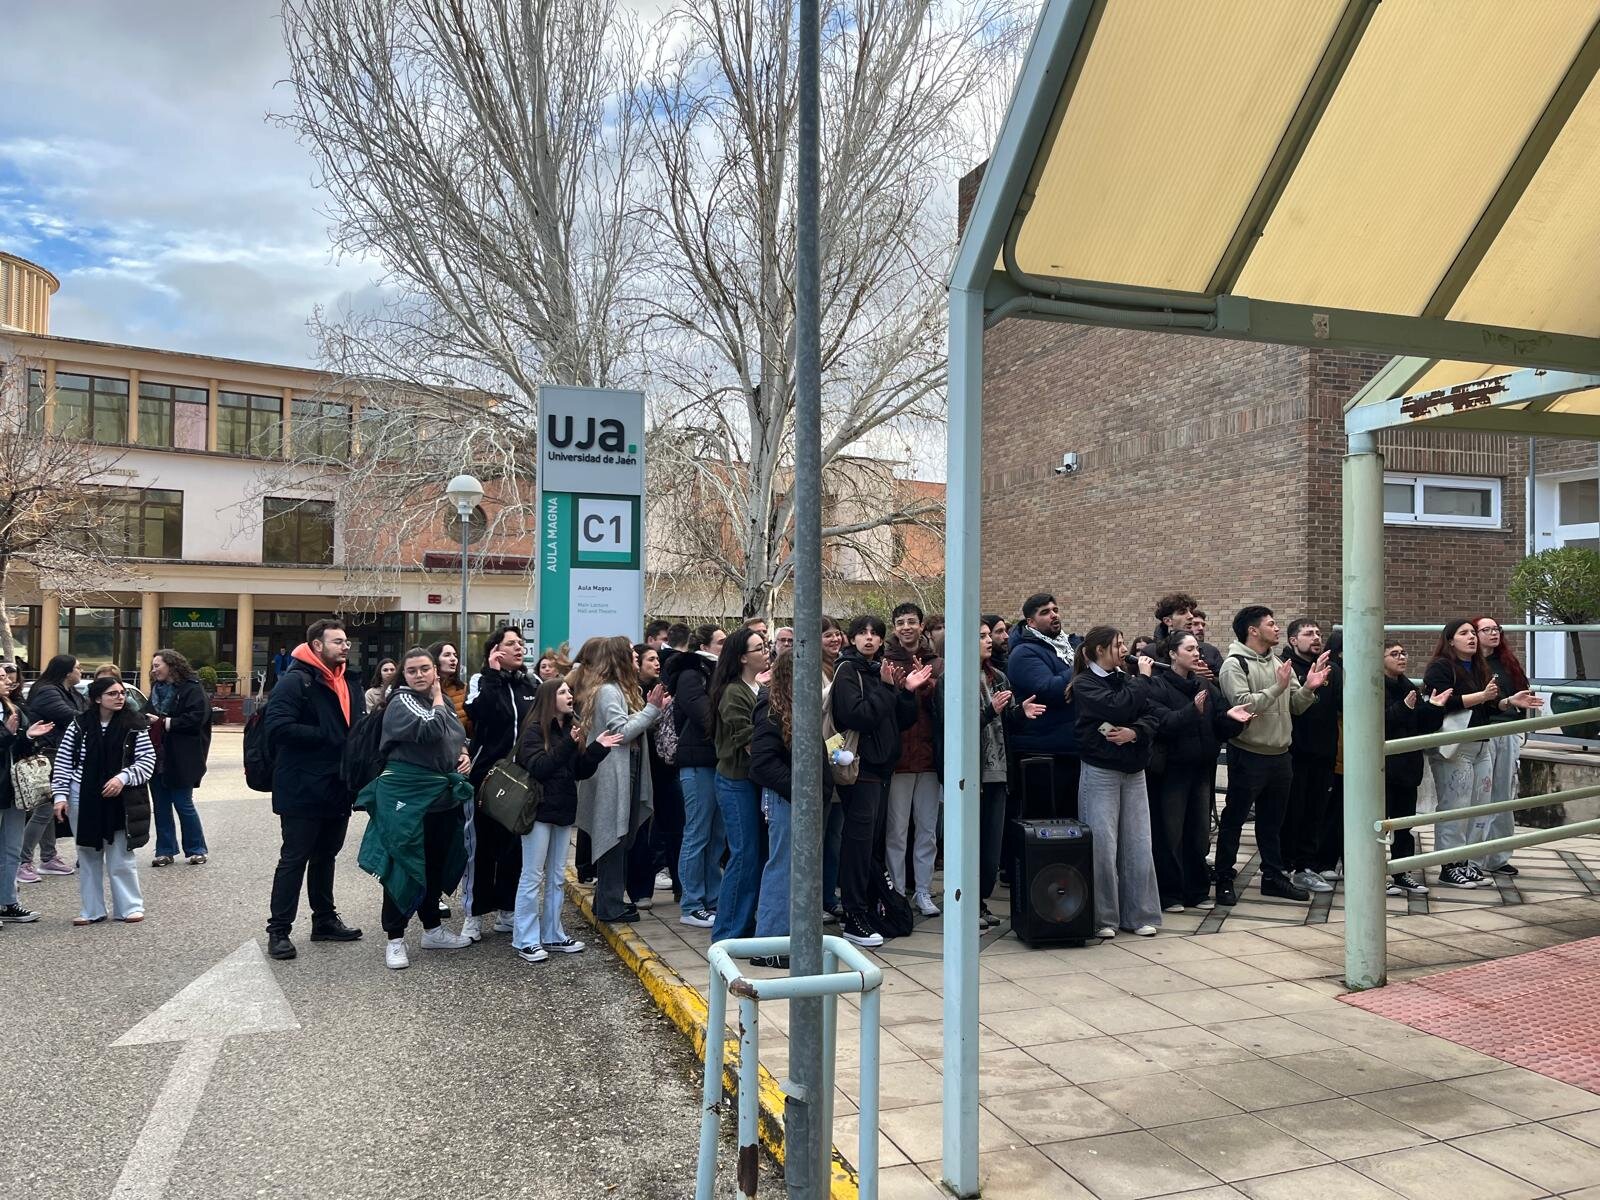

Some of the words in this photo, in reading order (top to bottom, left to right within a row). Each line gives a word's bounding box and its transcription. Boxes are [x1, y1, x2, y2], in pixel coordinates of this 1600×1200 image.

[548, 451, 601, 463] Universidad
[603, 454, 614, 464] de
[615, 454, 637, 465] Jaén
[547, 497, 558, 539] MAGNA
[583, 514, 621, 544] C1
[547, 542, 557, 573] AULA
